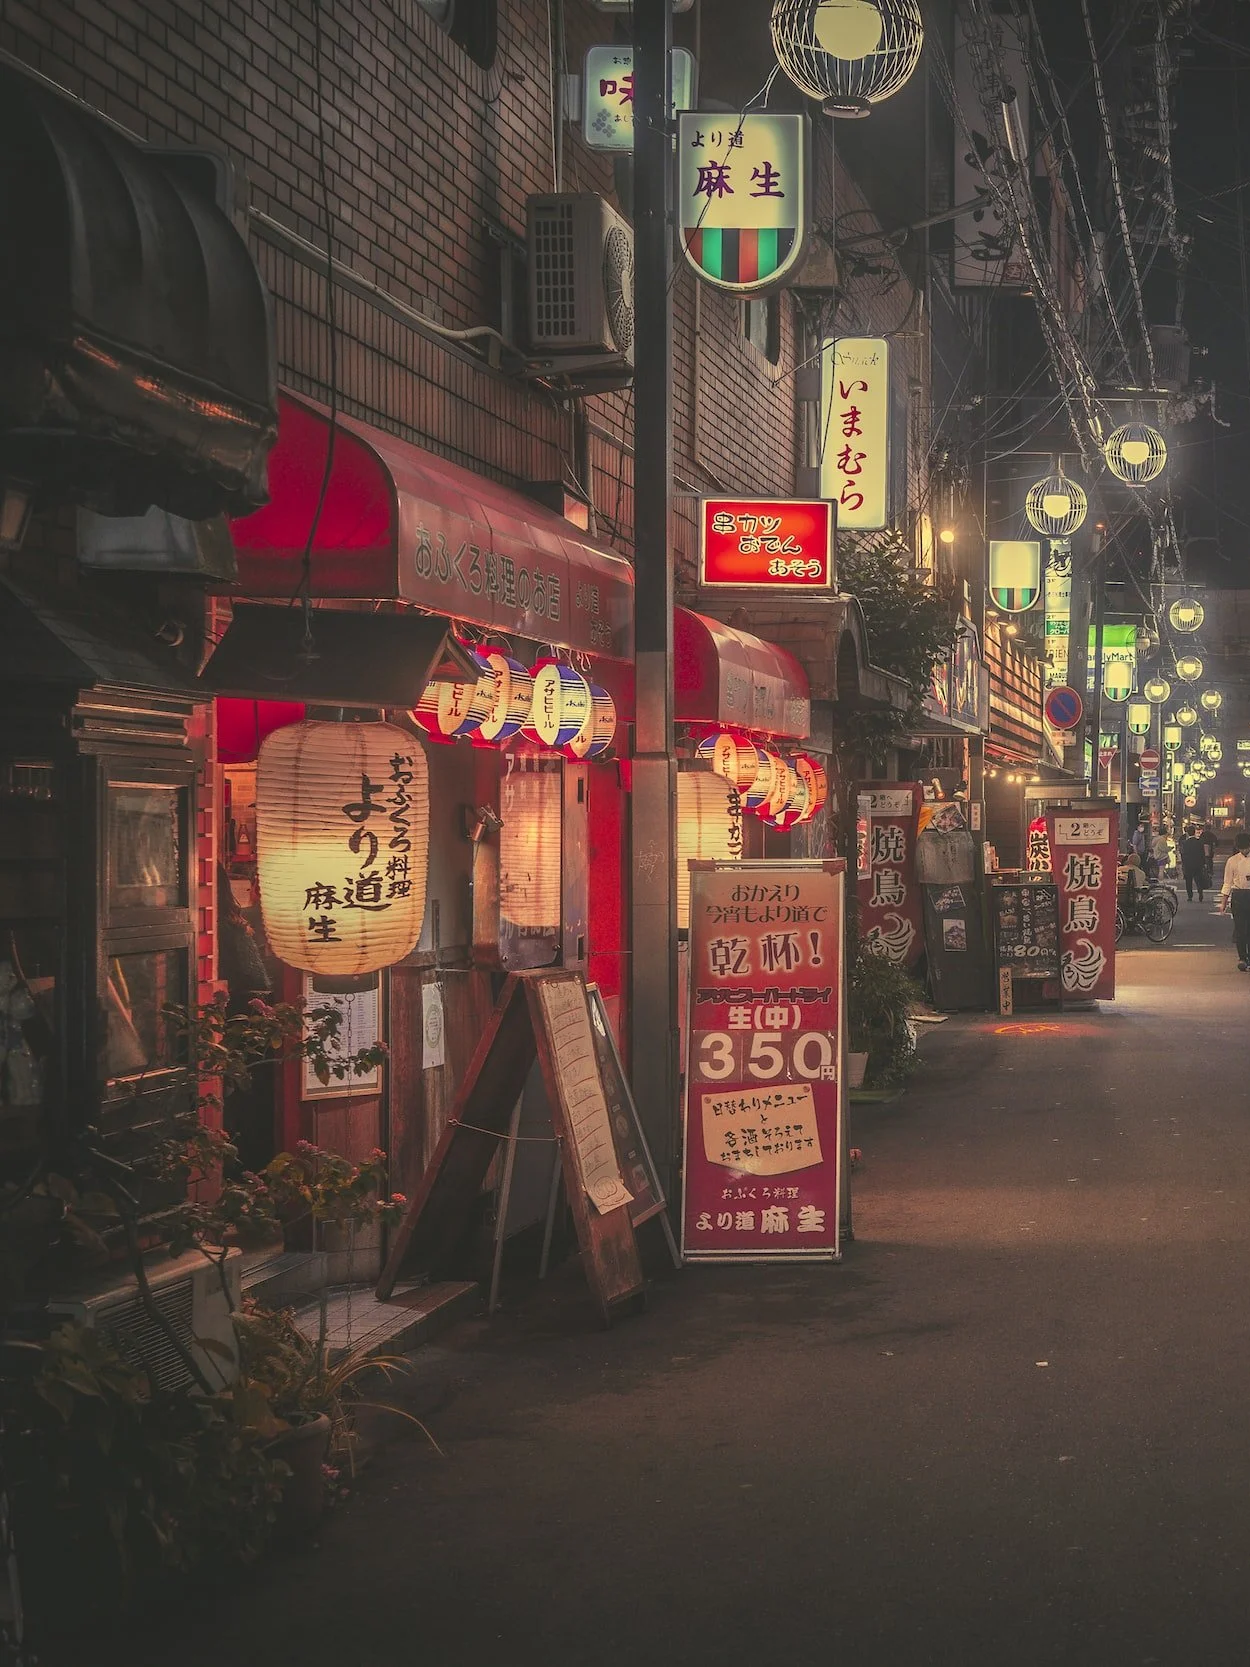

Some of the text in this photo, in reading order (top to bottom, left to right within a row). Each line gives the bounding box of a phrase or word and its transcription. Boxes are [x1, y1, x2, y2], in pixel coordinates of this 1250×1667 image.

[690, 130, 745, 149] より道
[692, 160, 786, 199] 麻生
[836, 380, 869, 511] いまむら
[713, 512, 782, 535] 串カツ
[739, 536, 803, 555] おでん
[413, 521, 562, 623] おふくろ料理のお店
[769, 559, 823, 578] あそう
[543, 680, 556, 729] アサヒビール
[721, 745, 731, 778] アサヒビー
[385, 752, 415, 899] おふくろ料理
[342, 773, 393, 912] より道
[871, 826, 907, 907] 焼鳥
[731, 884, 800, 902] おかえり
[1063, 852, 1103, 935] 焼鳥
[303, 881, 344, 943] 麻生
[705, 905, 828, 924] 今宵もより道で
[709, 931, 822, 977] 乾杯!
[728, 1005, 802, 1030] 生(中)
[712, 1094, 809, 1117] 日替わりメニュー
[760, 1113, 769, 1123] と
[721, 1187, 800, 1200] おふくろ料理
[695, 1205, 826, 1234] より道 麻生
